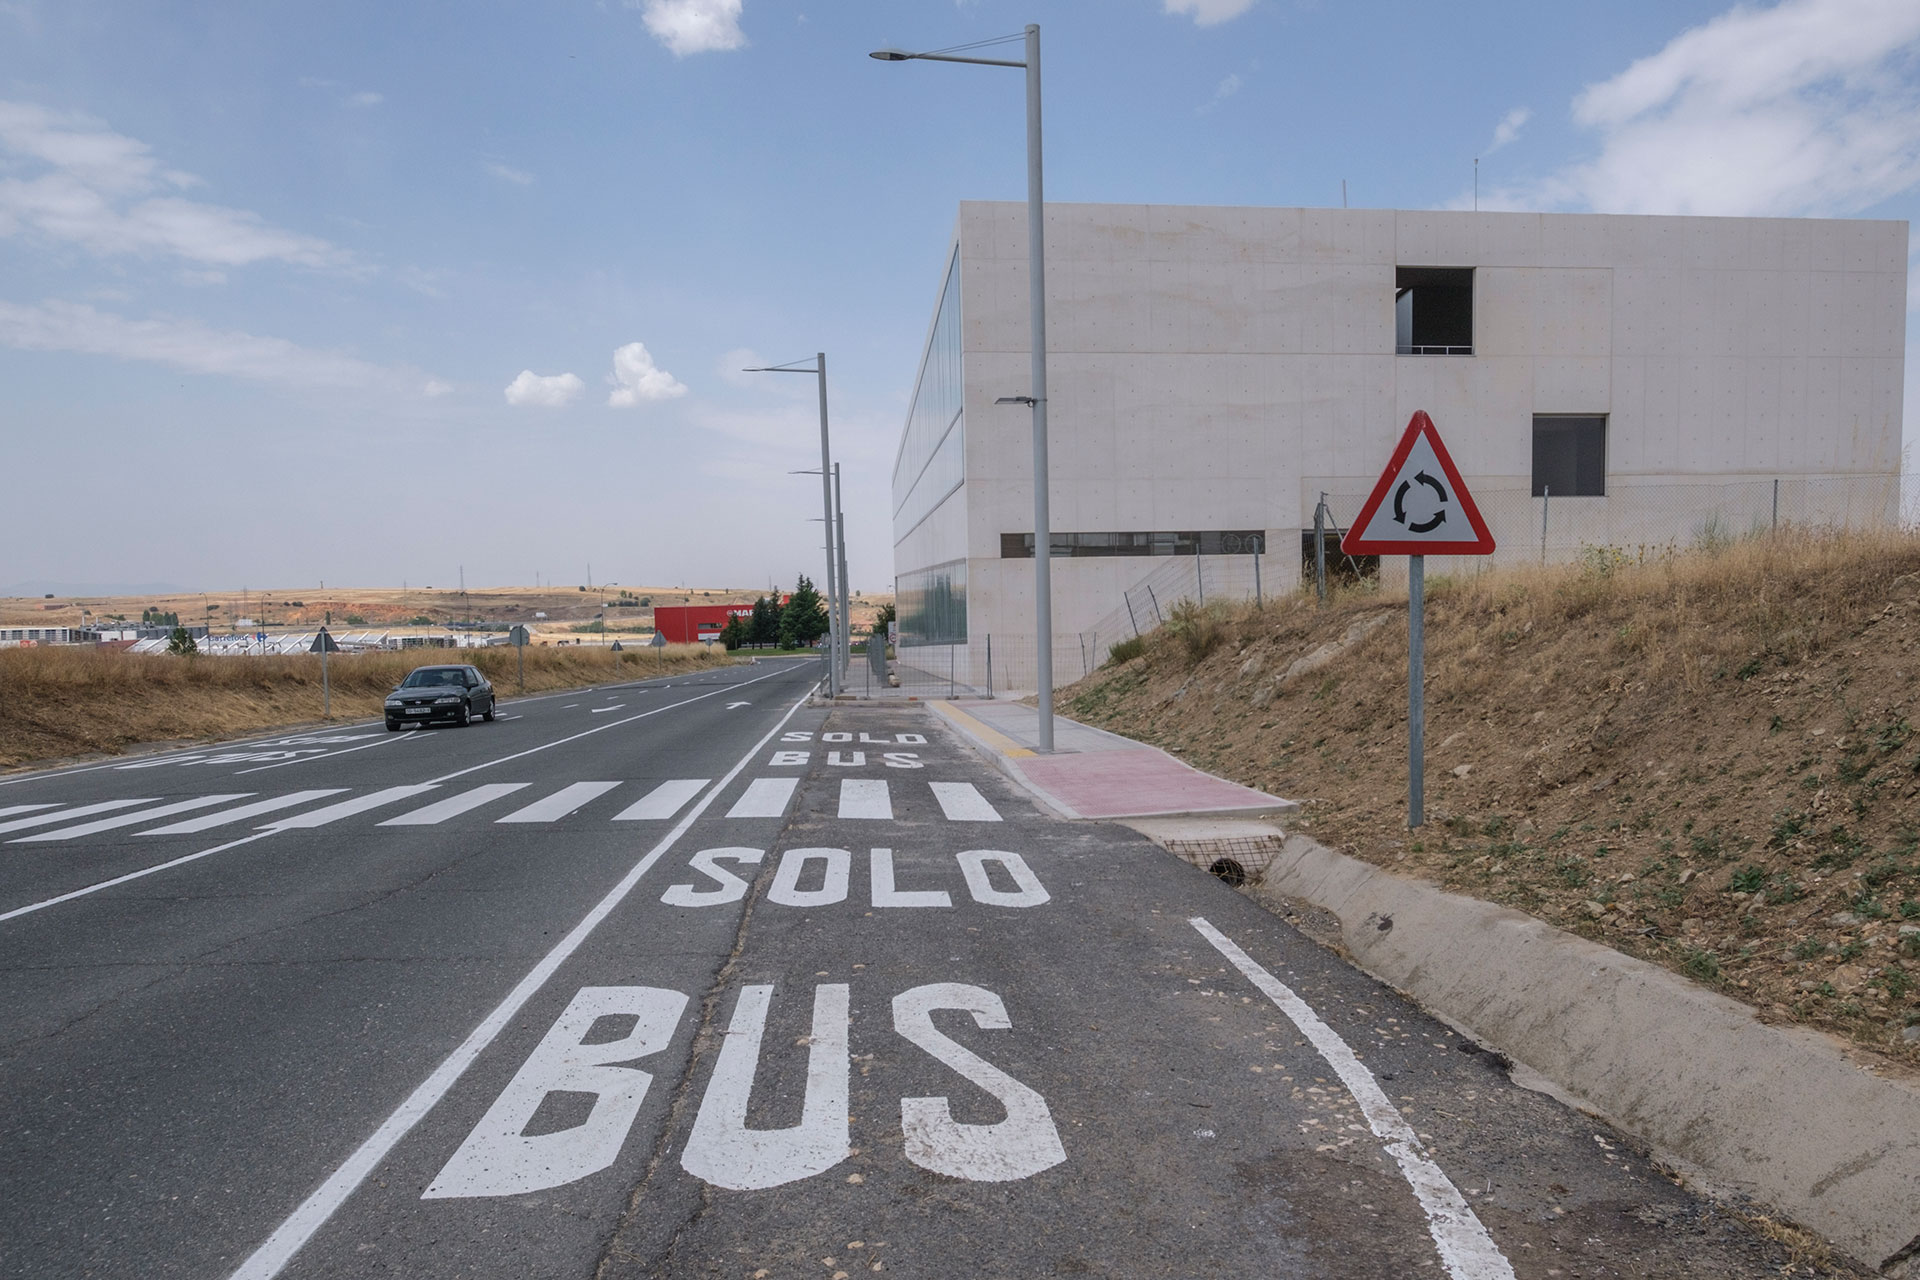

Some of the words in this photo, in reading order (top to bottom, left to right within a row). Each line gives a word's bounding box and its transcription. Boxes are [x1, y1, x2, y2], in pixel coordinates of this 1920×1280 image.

[208, 633, 249, 642] Carrefour
[780, 731, 928, 744] SOLO
[768, 751, 925, 769] BUS
[660, 846, 1051, 907] SOLO
[420, 982, 1067, 1198] BUS
